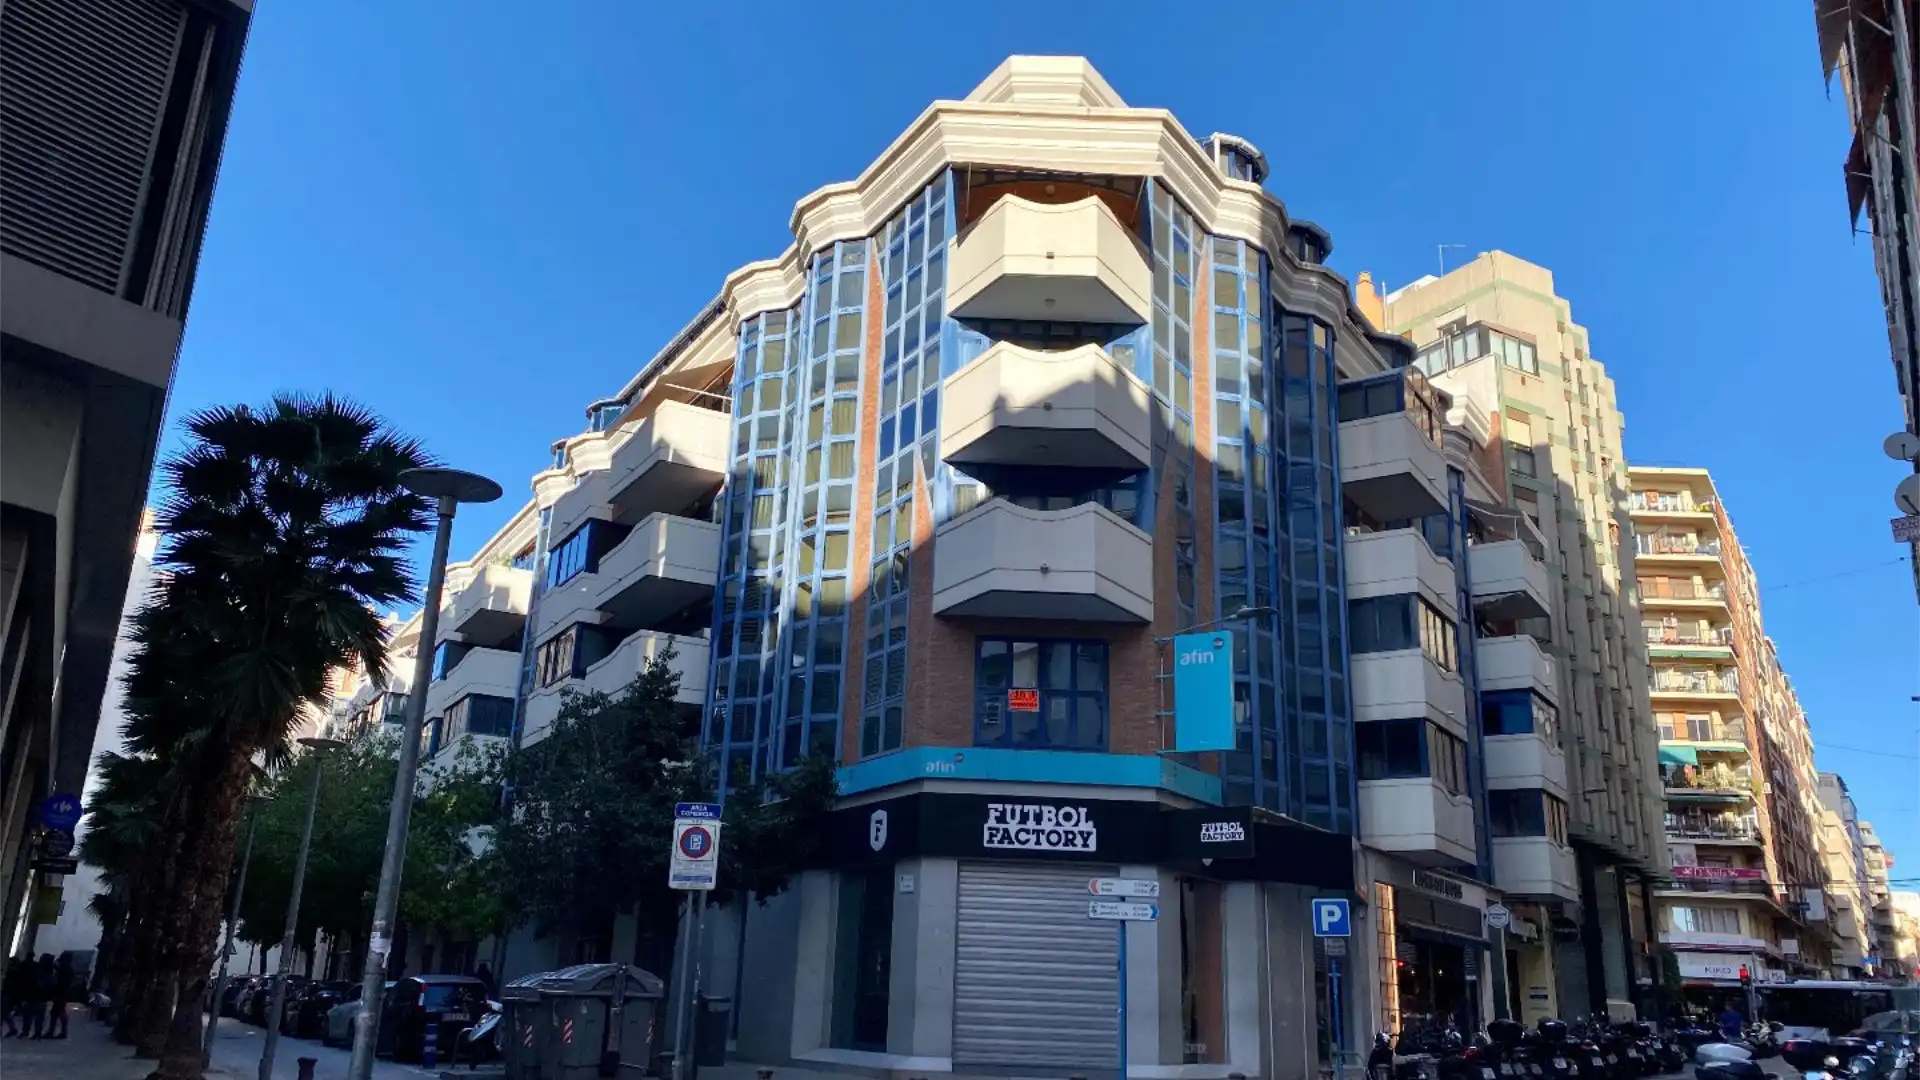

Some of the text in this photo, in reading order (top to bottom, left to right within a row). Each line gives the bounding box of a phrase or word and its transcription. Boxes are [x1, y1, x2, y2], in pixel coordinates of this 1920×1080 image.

[1180, 649, 1214, 666] afin
[925, 761, 956, 774] afin
[987, 804, 1095, 828] FUTBOL
[1201, 822, 1244, 833] FUTBOL
[1201, 831, 1244, 841] FACTORY
[985, 827, 1094, 849] FACTORY
[1320, 904, 1342, 931] P
